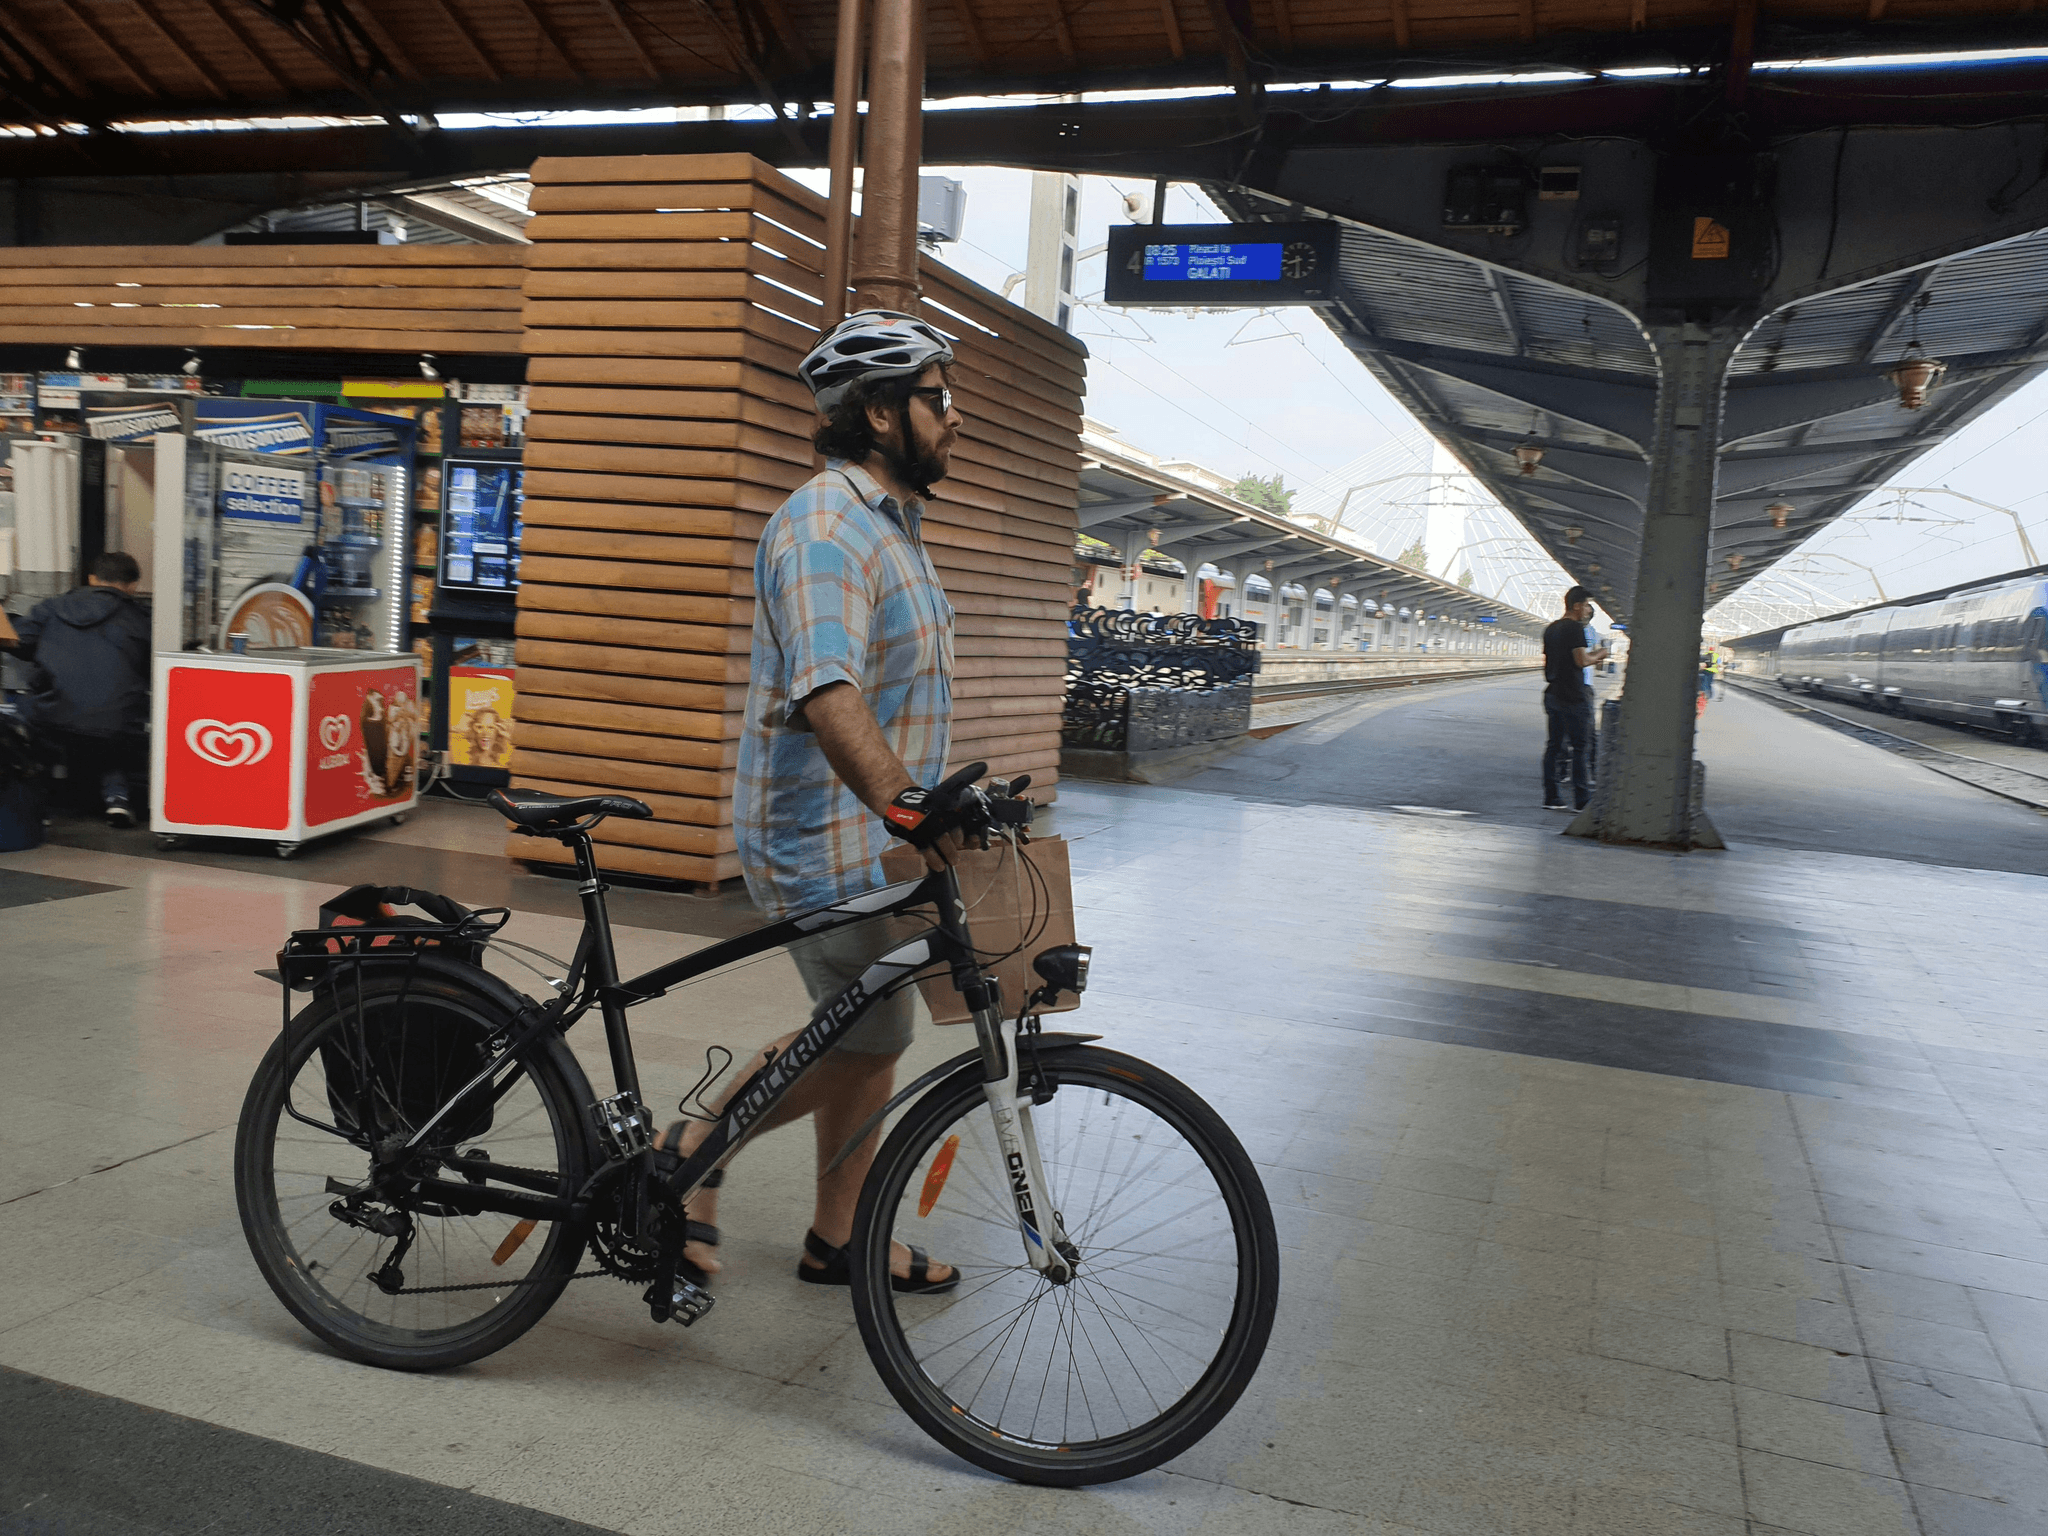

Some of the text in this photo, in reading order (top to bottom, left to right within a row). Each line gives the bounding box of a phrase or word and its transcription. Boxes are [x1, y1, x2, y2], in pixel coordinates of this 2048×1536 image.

[1126, 251, 1142, 274] 4
[226, 472, 300, 496] COFFEE
[226, 496, 302, 517] selection
[600, 799, 633, 810] PRO
